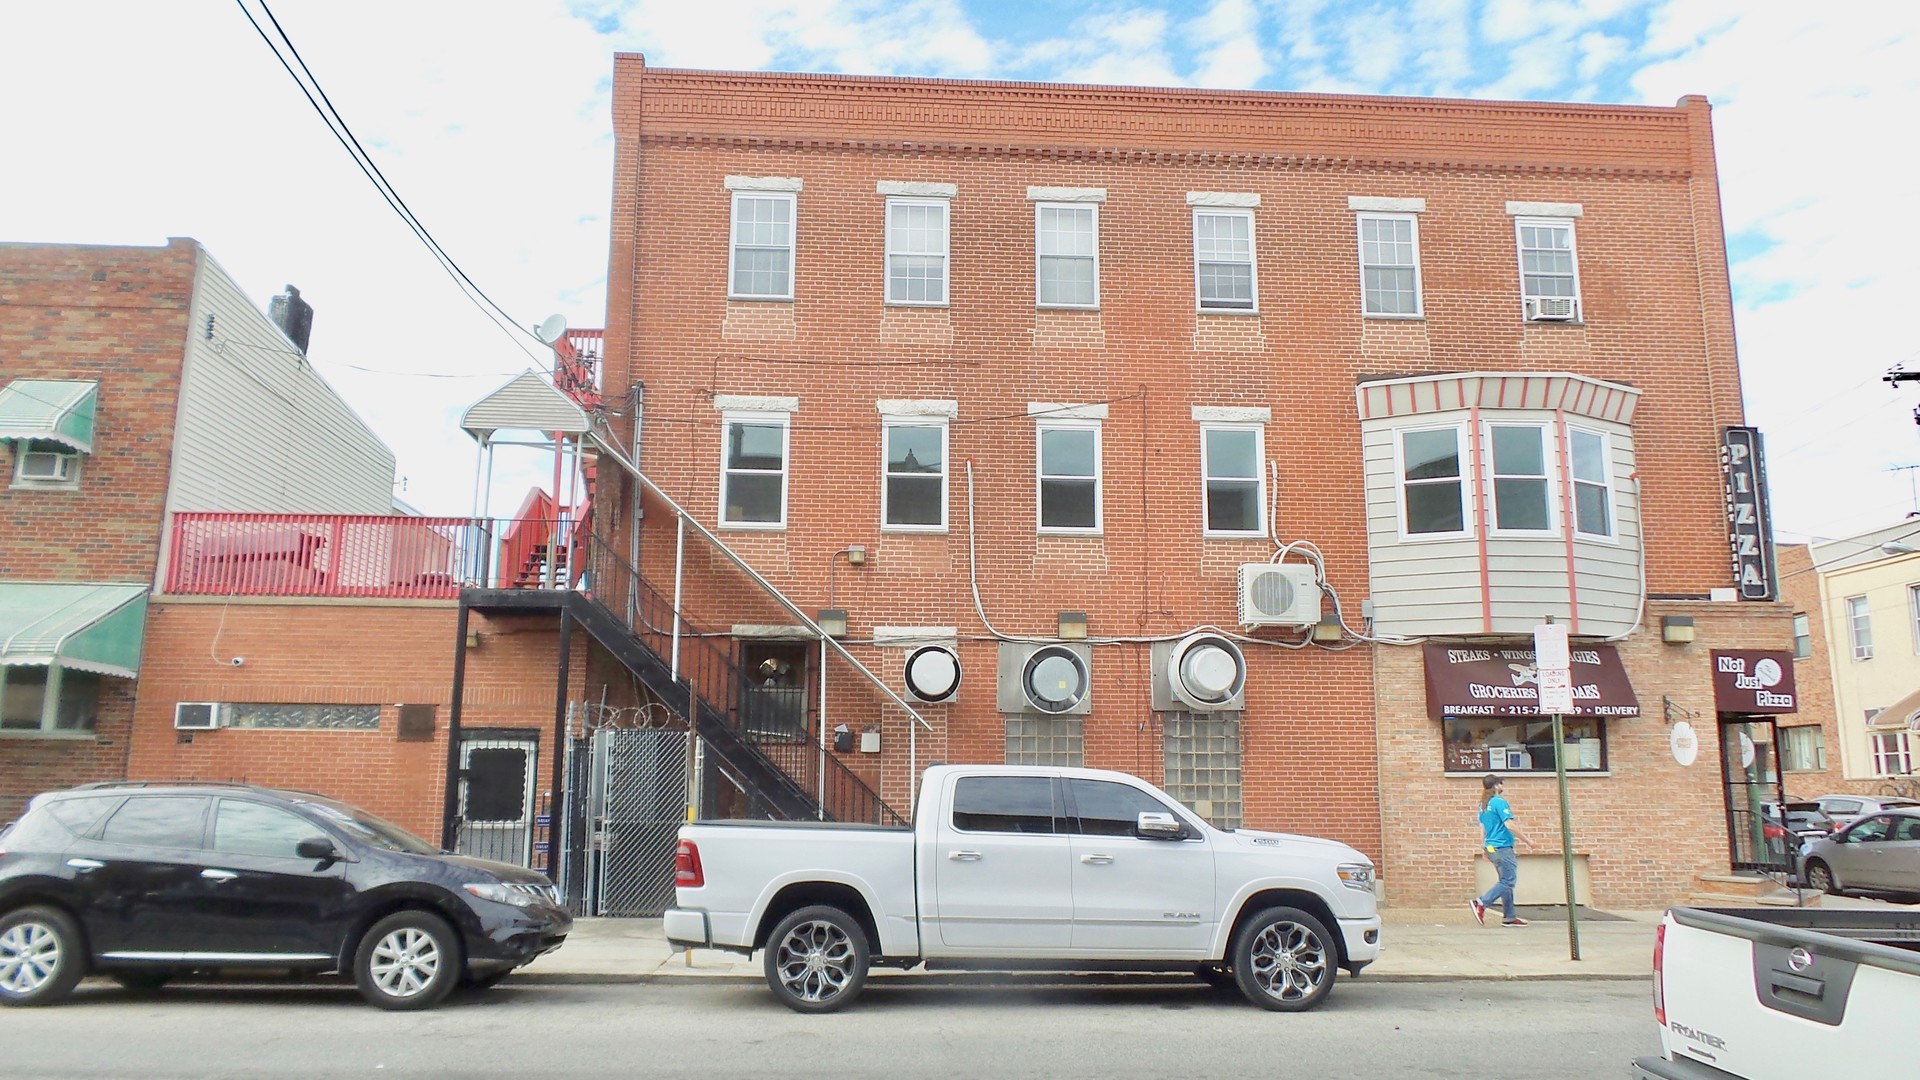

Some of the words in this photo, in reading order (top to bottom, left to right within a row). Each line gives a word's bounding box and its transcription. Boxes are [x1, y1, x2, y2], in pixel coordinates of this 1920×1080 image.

[1729, 444, 1763, 585] PIZZA
[1448, 649, 1491, 664] STEAKS
[1569, 649, 1601, 665] AGIES
[1718, 656, 1744, 672] Not
[1735, 673, 1762, 688] Just
[1469, 683, 1538, 699] GROCERIES
[1571, 684, 1601, 699] DAES
[1756, 690, 1793, 707] Pizza
[1443, 705, 1495, 714] BREAKFAST
[1594, 706, 1639, 715] DELIVERY
[1670, 1021, 1728, 1052] FRONTIER
